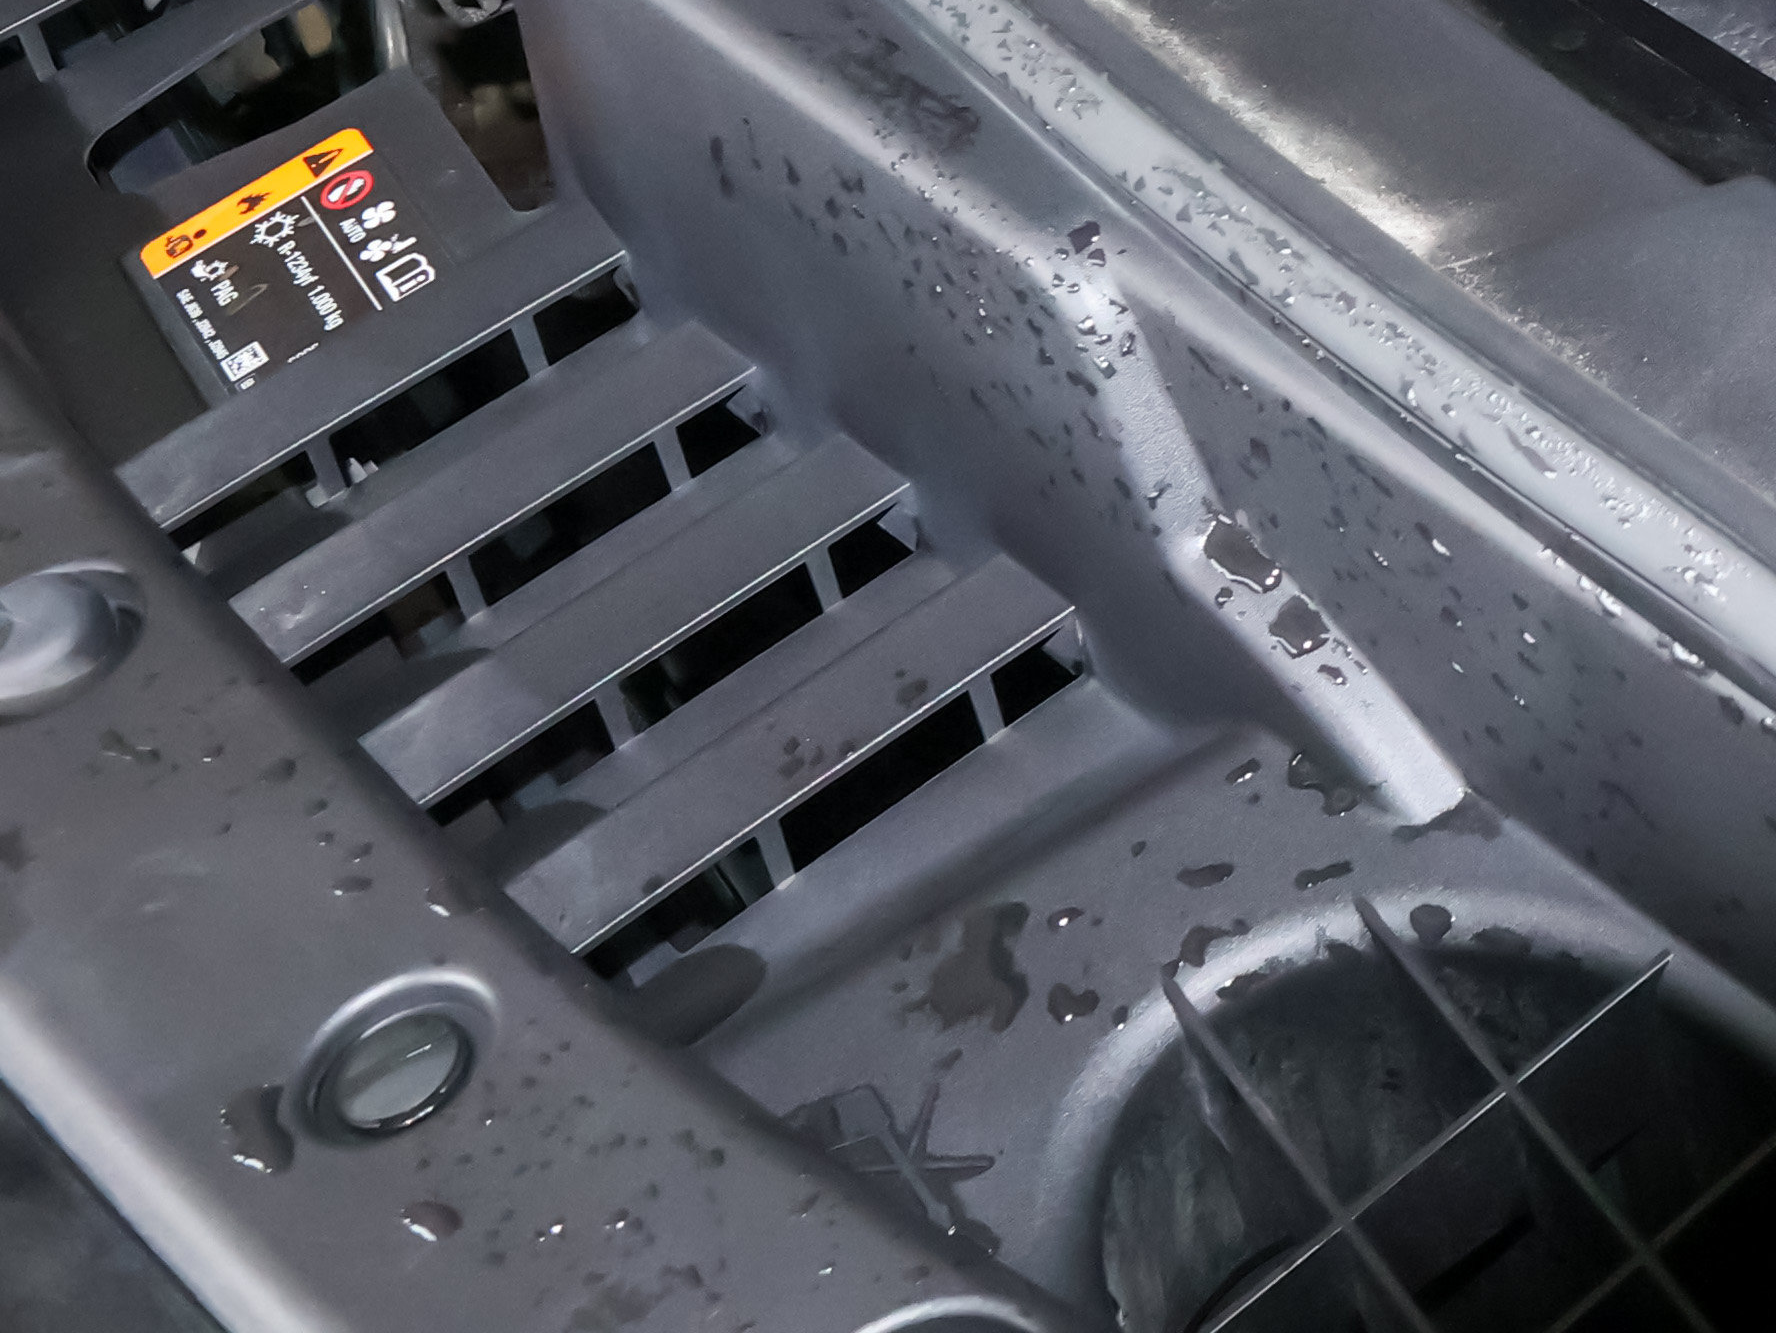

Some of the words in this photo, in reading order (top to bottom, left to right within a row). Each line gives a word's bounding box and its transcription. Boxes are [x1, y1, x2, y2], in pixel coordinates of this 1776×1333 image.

[338, 217, 367, 244] AUTO
[210, 279, 239, 307] PAG
[276, 240, 319, 287] R-1234yf
[307, 285, 339, 316] 1.000
[323, 309, 344, 331] kg
